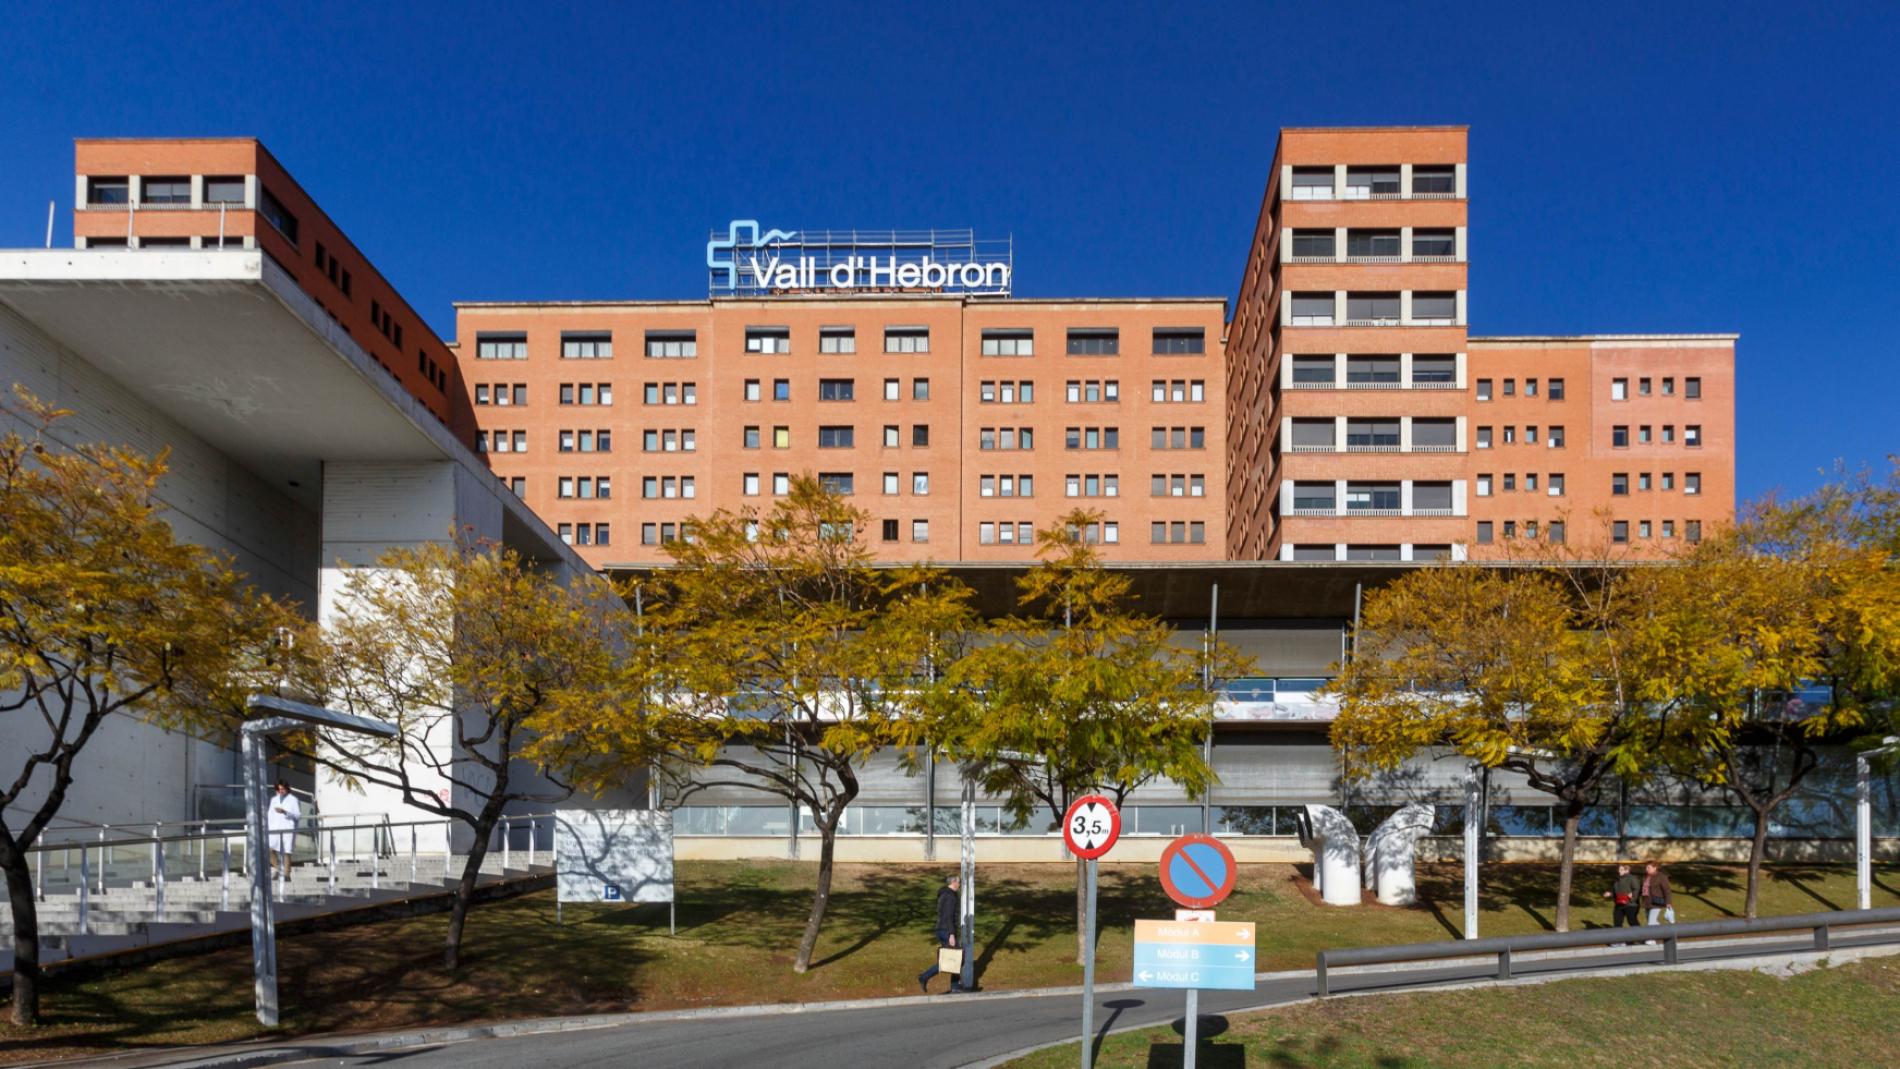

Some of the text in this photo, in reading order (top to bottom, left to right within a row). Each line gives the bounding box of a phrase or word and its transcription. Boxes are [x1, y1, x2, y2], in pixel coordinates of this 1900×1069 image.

[750, 255, 1009, 288] Vall d'Hebron
[607, 886, 617, 898] P
[1191, 928, 1200, 937] A
[1191, 949, 1200, 959] B
[1190, 971, 1200, 982] C
